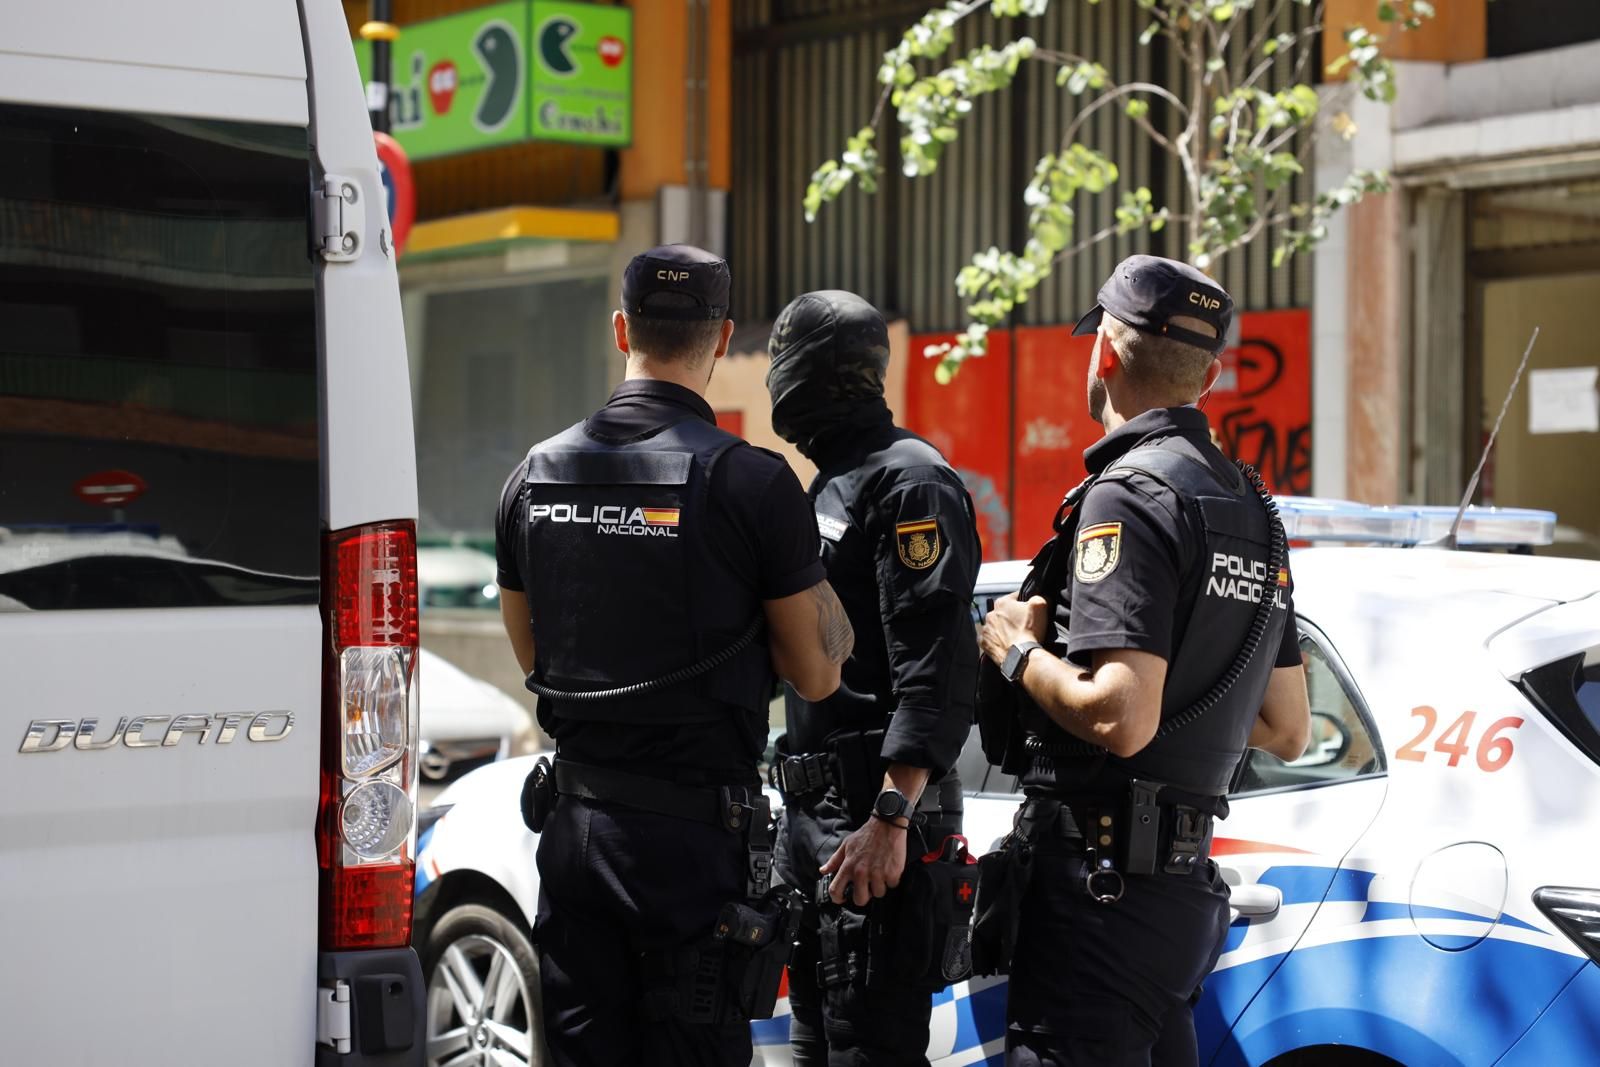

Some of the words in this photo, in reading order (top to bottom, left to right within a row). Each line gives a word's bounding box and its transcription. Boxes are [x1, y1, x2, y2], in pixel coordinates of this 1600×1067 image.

[657, 270, 690, 282] CNP
[1189, 291, 1221, 310] CNP
[529, 504, 647, 526] POLICIA
[597, 524, 678, 538] NACIONAL
[1211, 552, 1268, 582] POLICI
[1206, 575, 1287, 610] NACIOAL
[18, 710, 296, 753] DUCATO
[1395, 704, 1525, 773] 246
